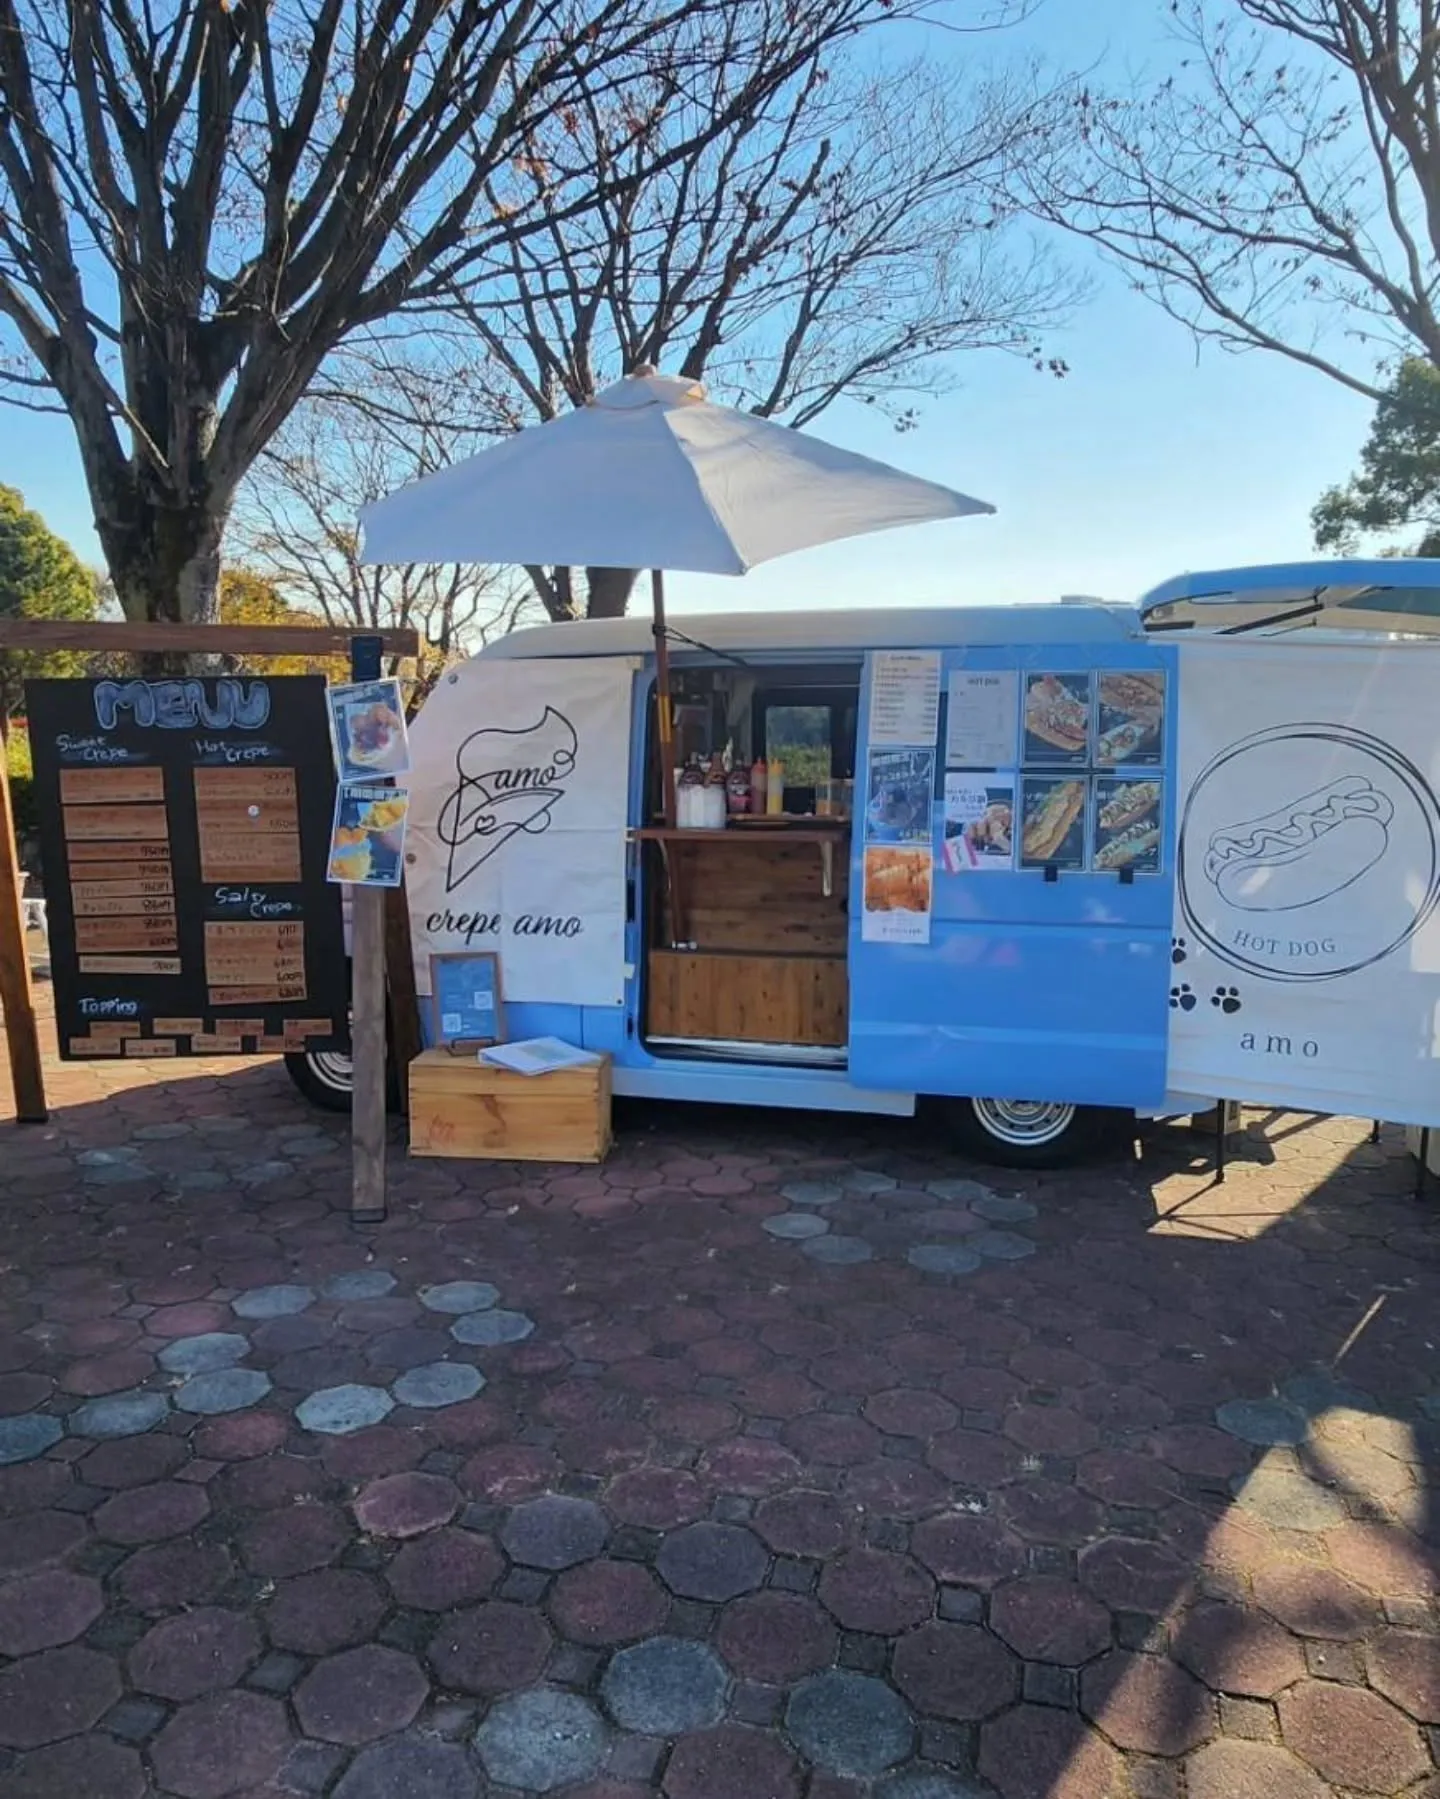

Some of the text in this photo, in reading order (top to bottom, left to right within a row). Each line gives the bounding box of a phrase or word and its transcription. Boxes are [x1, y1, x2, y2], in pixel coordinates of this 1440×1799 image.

[93, 679, 271, 730] MENU
[494, 765, 557, 791] amo
[426, 909, 583, 945] crepe amo
[1232, 929, 1336, 957] HOT DOG
[1240, 1032, 1319, 1058] amo
